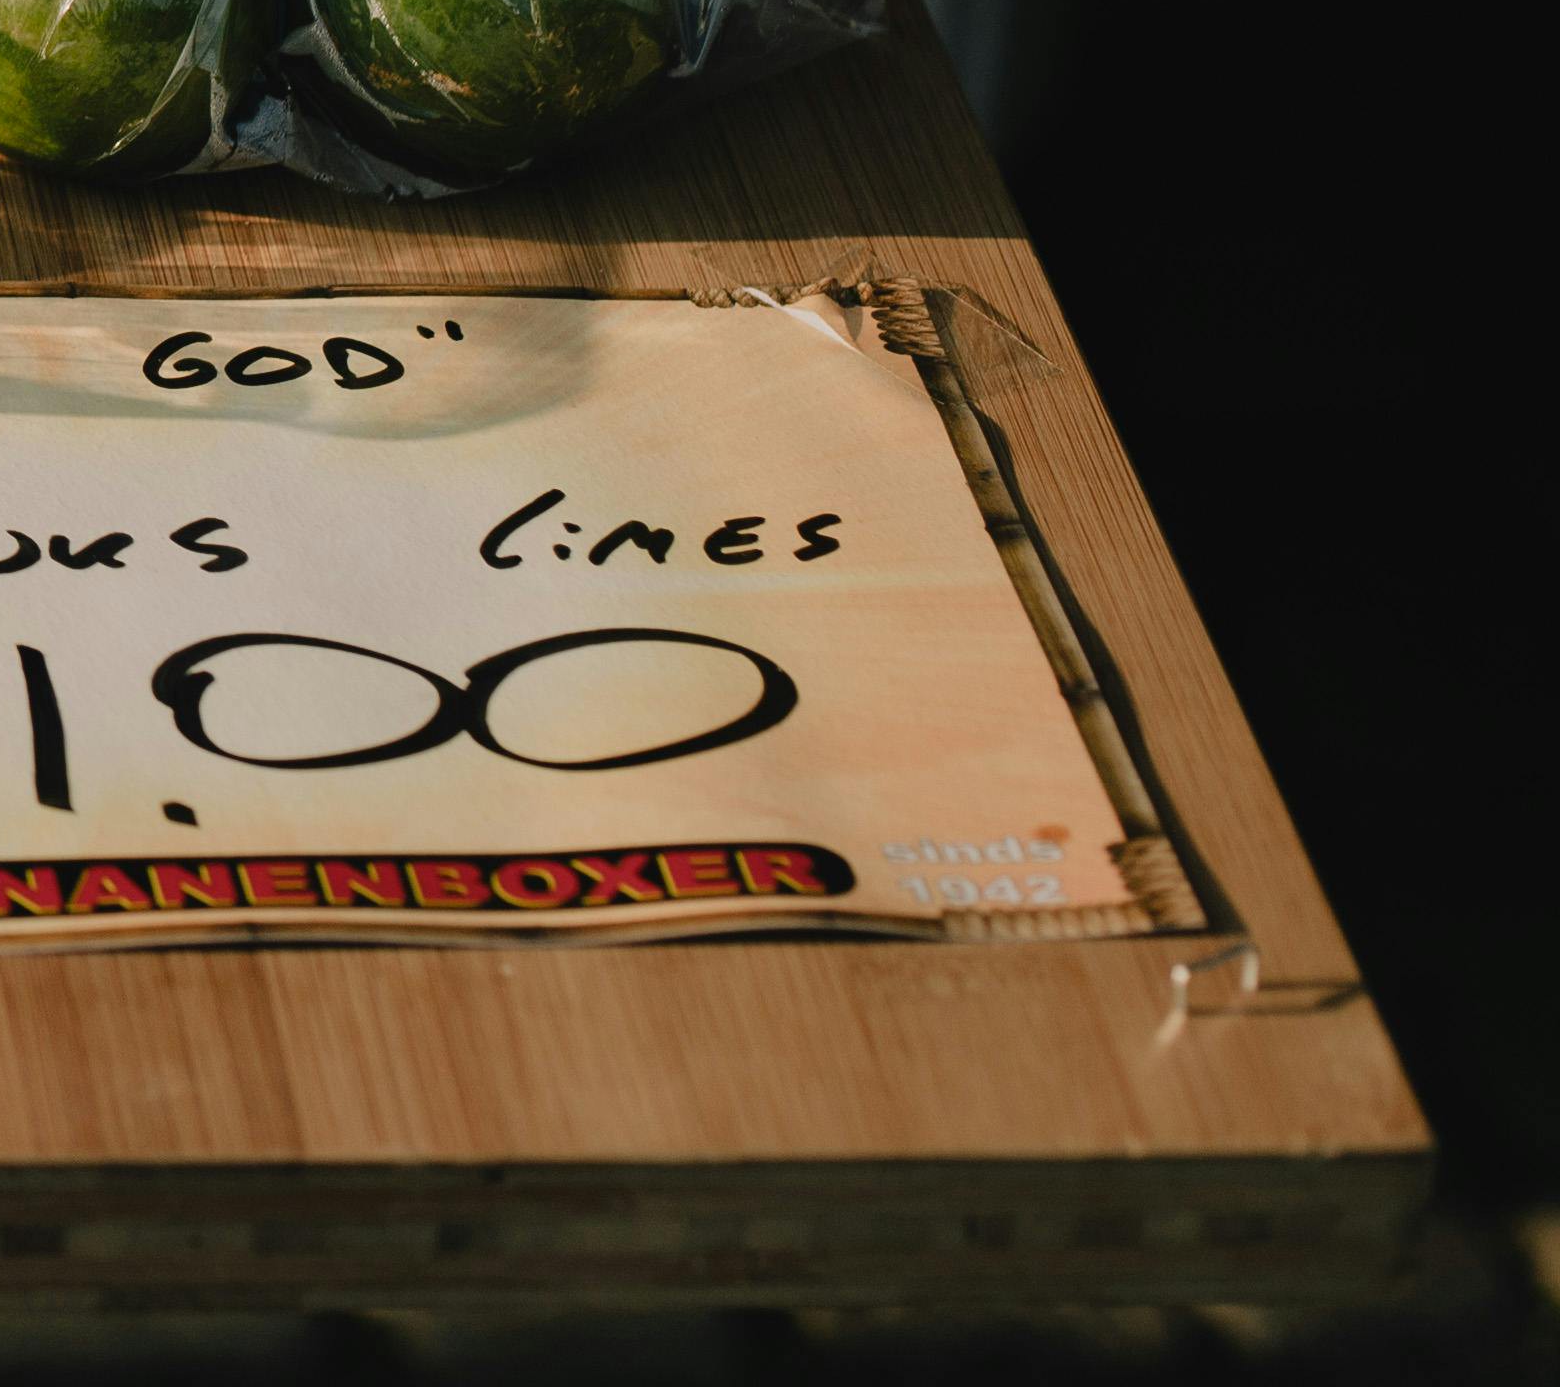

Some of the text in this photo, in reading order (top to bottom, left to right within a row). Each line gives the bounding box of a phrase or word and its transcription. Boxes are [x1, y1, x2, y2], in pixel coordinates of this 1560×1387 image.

[16, 627, 799, 827] 1.00
[882, 836, 1065, 868] sinds
[897, 872, 1068, 908] 1942
